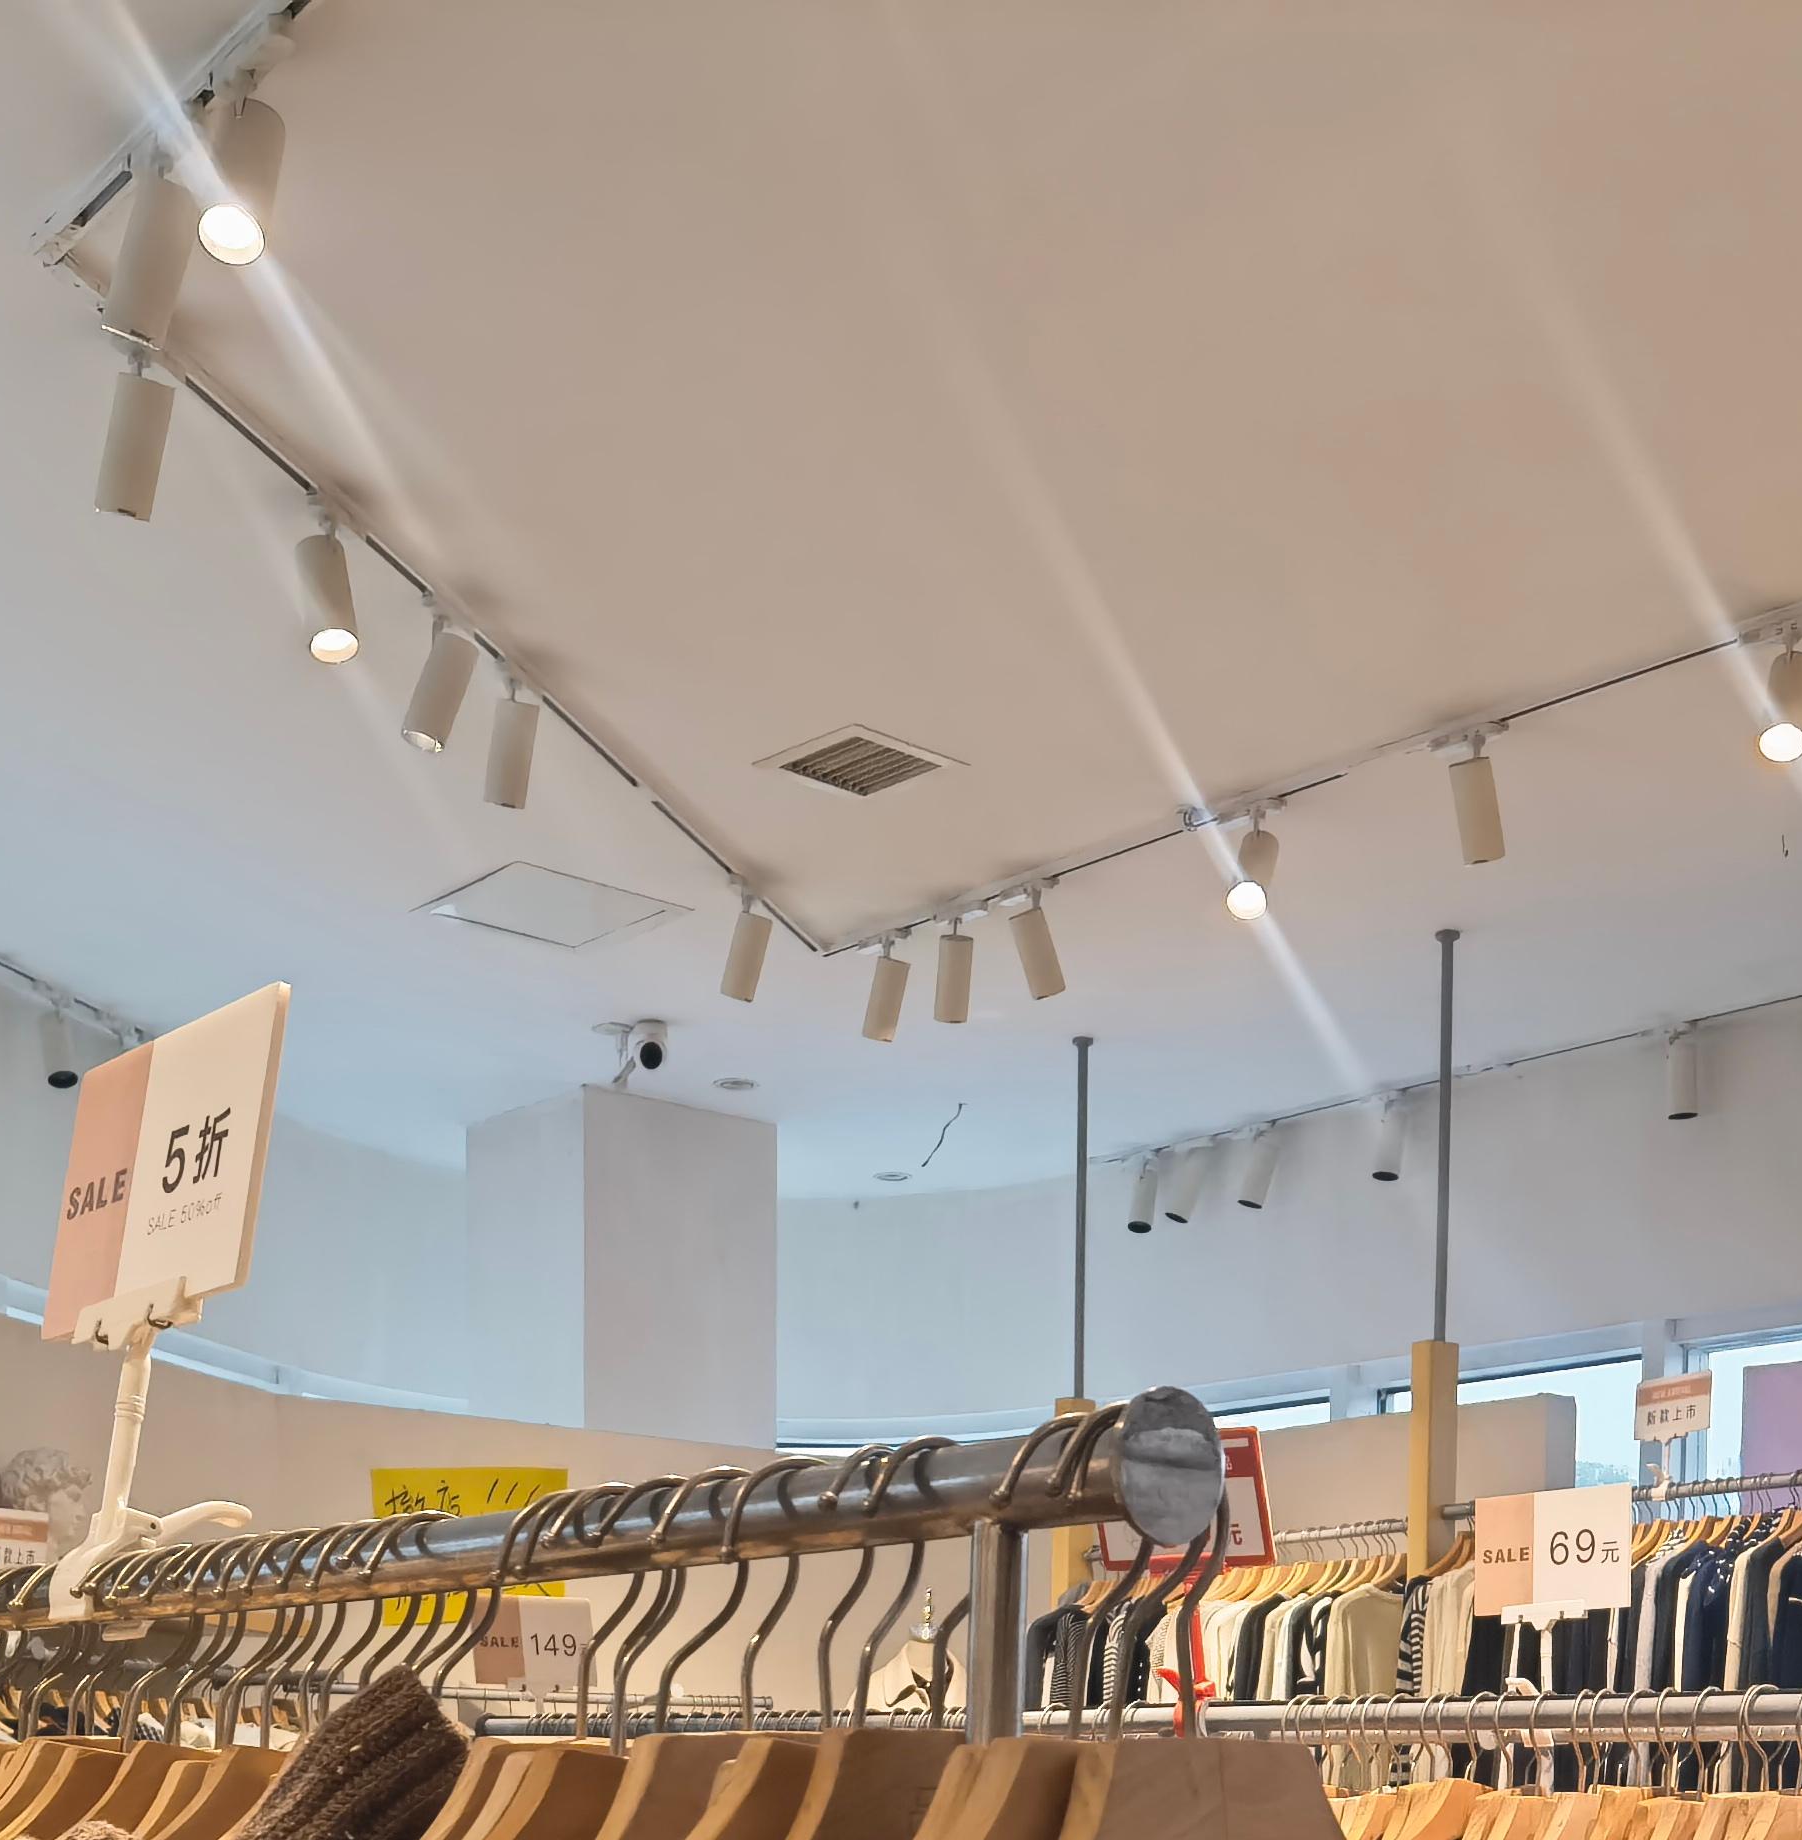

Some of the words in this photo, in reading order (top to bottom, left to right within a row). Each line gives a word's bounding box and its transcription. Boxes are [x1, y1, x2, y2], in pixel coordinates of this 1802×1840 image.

[162, 1107, 231, 1194] 5折
[66, 1167, 128, 1221] SALE
[146, 1208, 177, 1236] SALE
[1482, 1547, 1530, 1564] SALE
[1549, 1528, 1620, 1565] 69元
[479, 1636, 519, 1648] SALE
